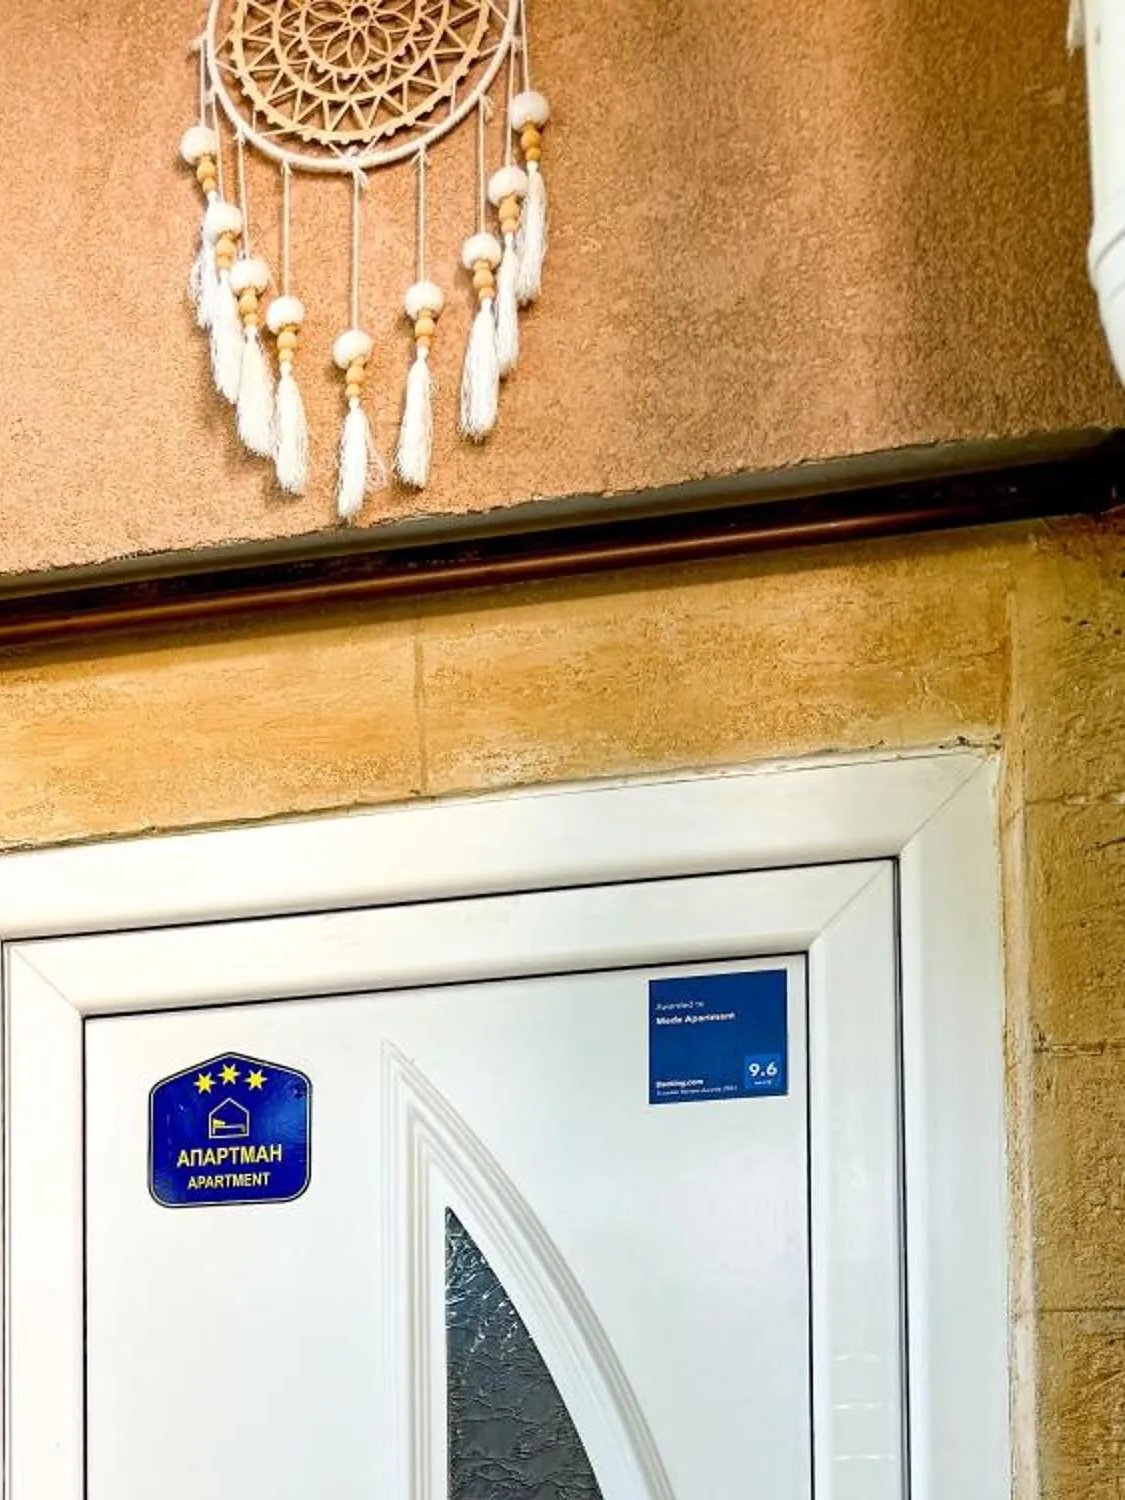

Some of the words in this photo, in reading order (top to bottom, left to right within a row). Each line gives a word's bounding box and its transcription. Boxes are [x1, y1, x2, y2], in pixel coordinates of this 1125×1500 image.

[749, 1060, 778, 1077] 9.6
[176, 1144, 283, 1168] АПАРТМАН
[187, 1172, 271, 1190] APARTMENT
